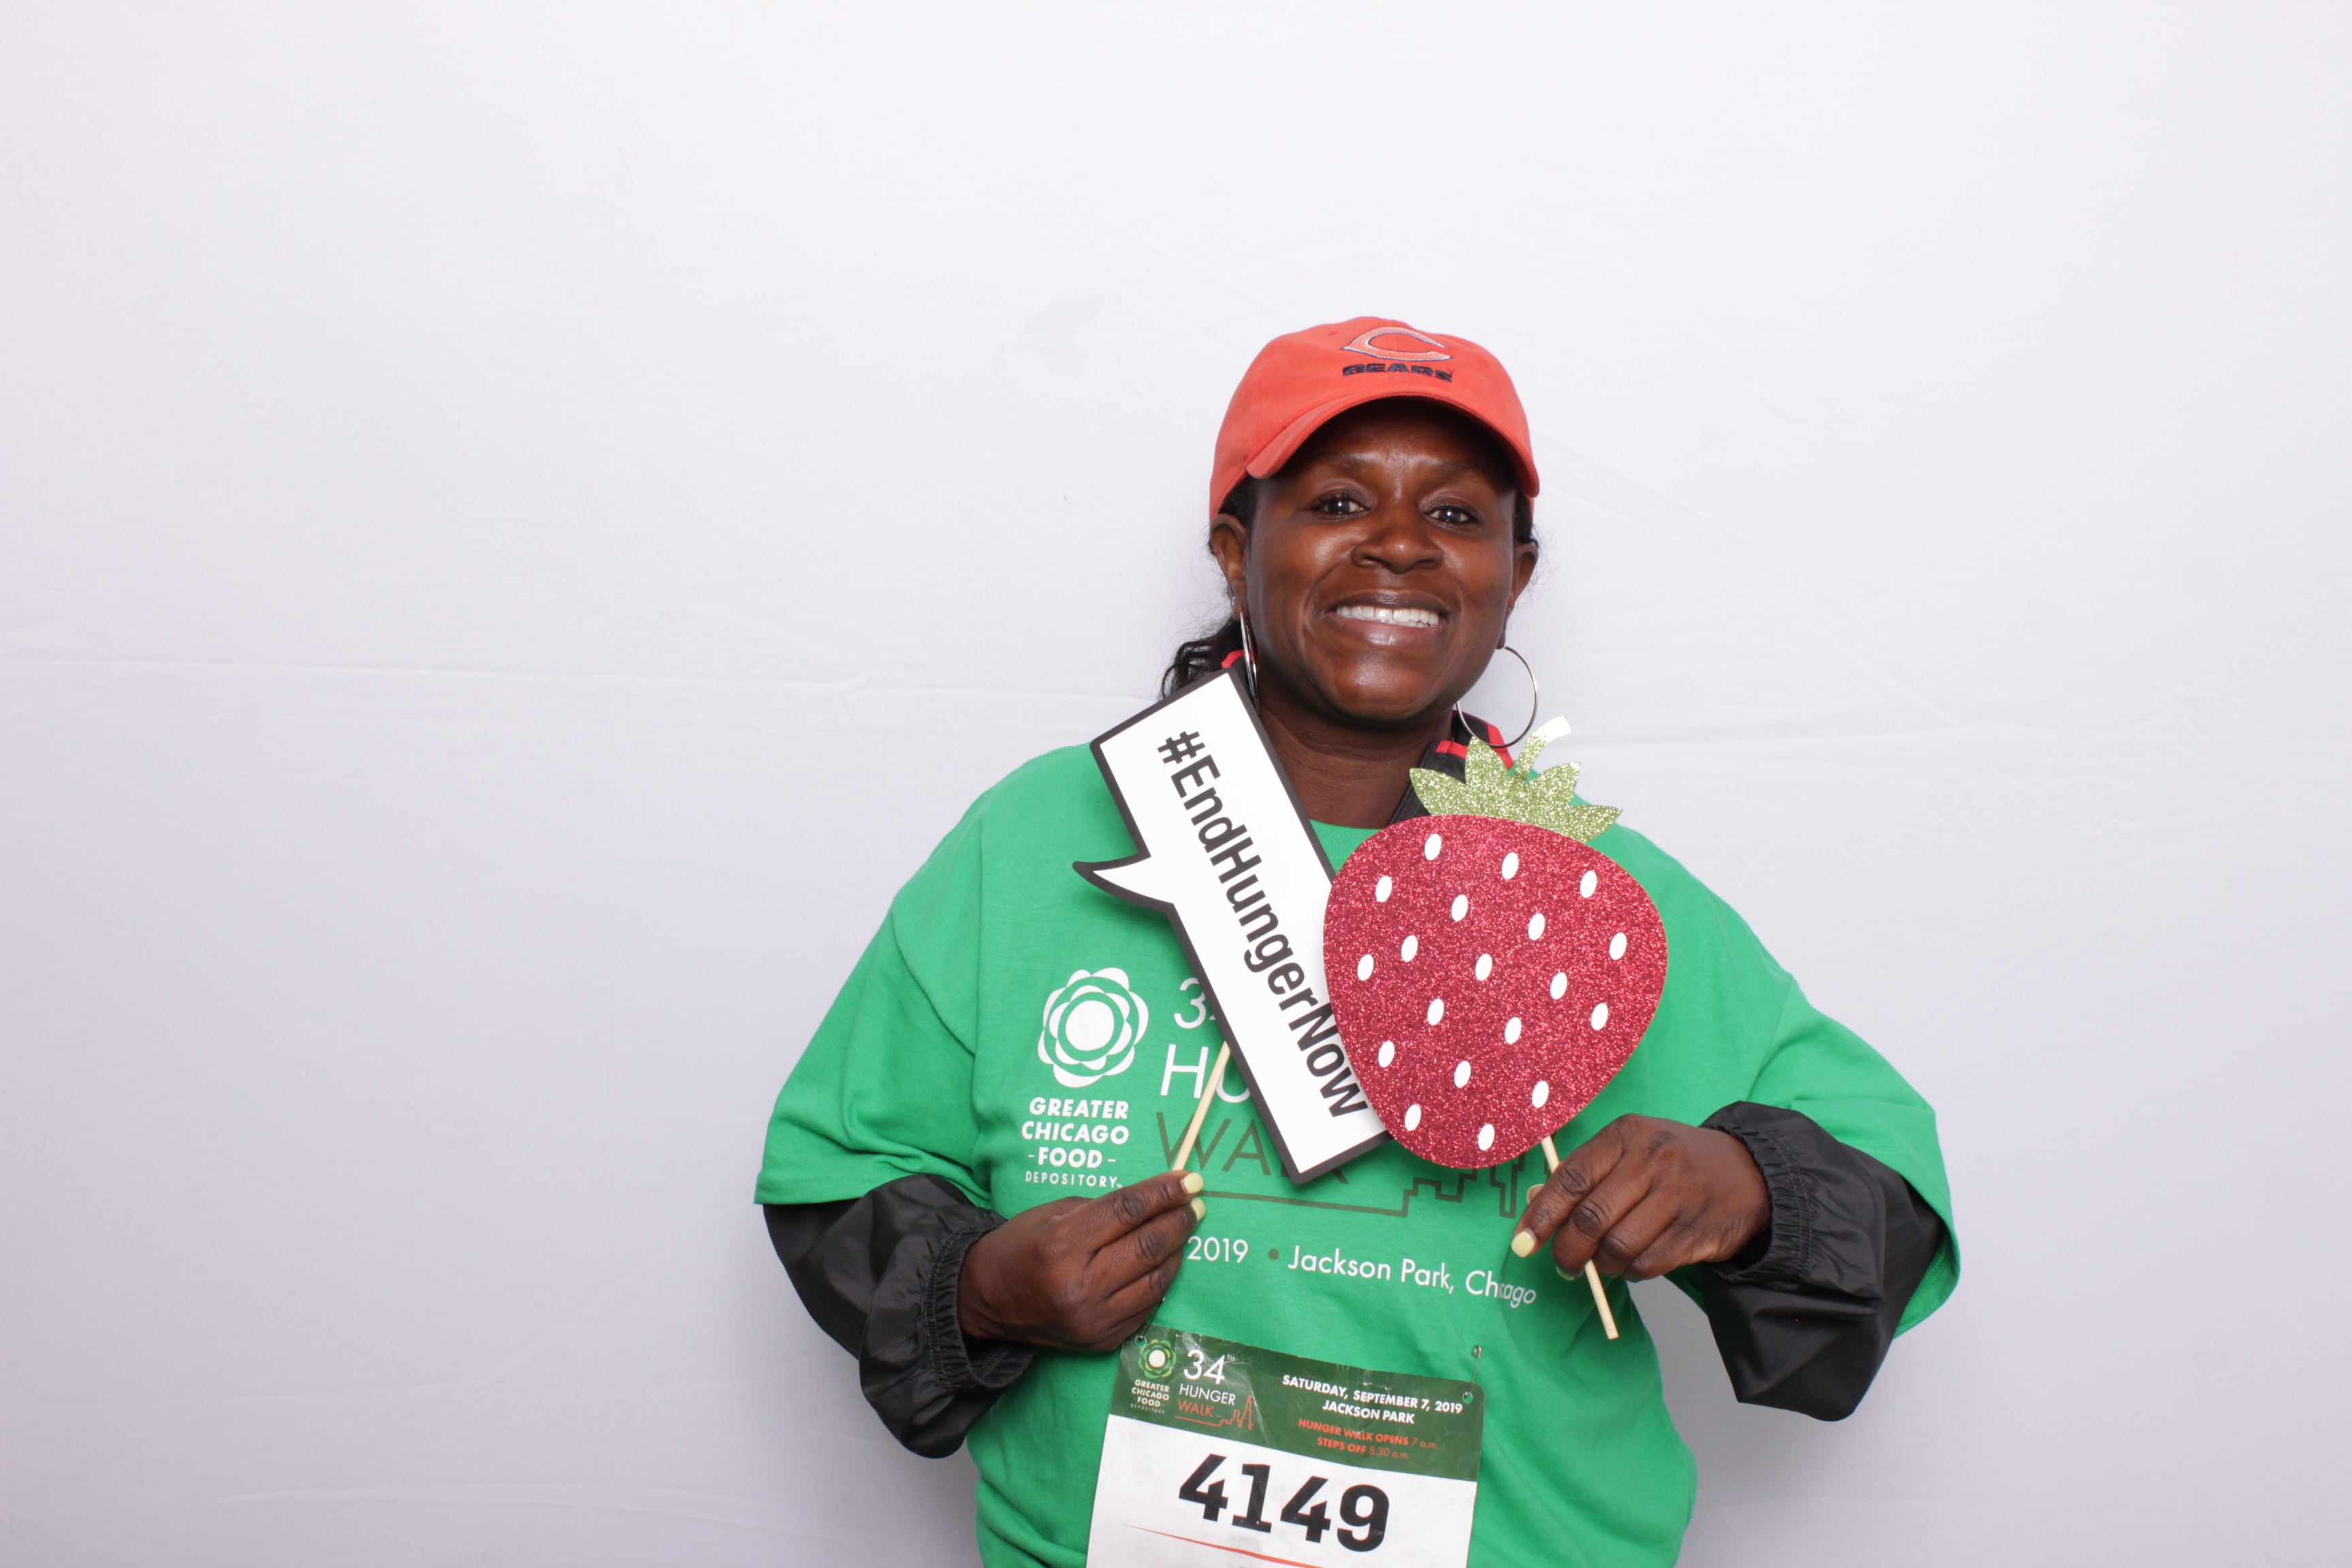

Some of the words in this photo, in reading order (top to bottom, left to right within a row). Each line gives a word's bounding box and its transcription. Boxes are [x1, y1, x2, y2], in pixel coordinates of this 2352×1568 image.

[1343, 363, 1452, 383] BEARS
[1157, 730, 1369, 1117] #EndHungerNow
[1029, 1096, 1129, 1120] GREATER
[1022, 1121, 1130, 1145] CHICAGO
[1187, 1235, 1249, 1264] 2019
[1288, 1245, 1392, 1280] Jackson
[1401, 1258, 1455, 1294] Park,
[1131, 1386, 1170, 1401] CHICAGO
[1134, 1379, 1170, 1393] GREATER
[1179, 1383, 1236, 1406] HUNGER
[1282, 1374, 1348, 1400] SATURDAY,
[1353, 1390, 1418, 1409] SEPTEMBER
[1420, 1399, 1431, 1412] 7,
[1435, 1400, 1463, 1414] 2019
[1177, 1399, 1215, 1418] WALK
[1322, 1399, 1380, 1420] JACKSON
[1382, 1410, 1415, 1424] PARK
[1298, 1418, 1341, 1436] HUNGER
[1344, 1428, 1373, 1441] WALK
[1375, 1433, 1409, 1446] OPENS
[1411, 1437, 1418, 1447] 7
[1317, 1437, 1345, 1451] STEPS
[1347, 1442, 1367, 1454] OFF
[1369, 1446, 1390, 1458] 8:30
[1178, 1453, 1390, 1552] 4149
